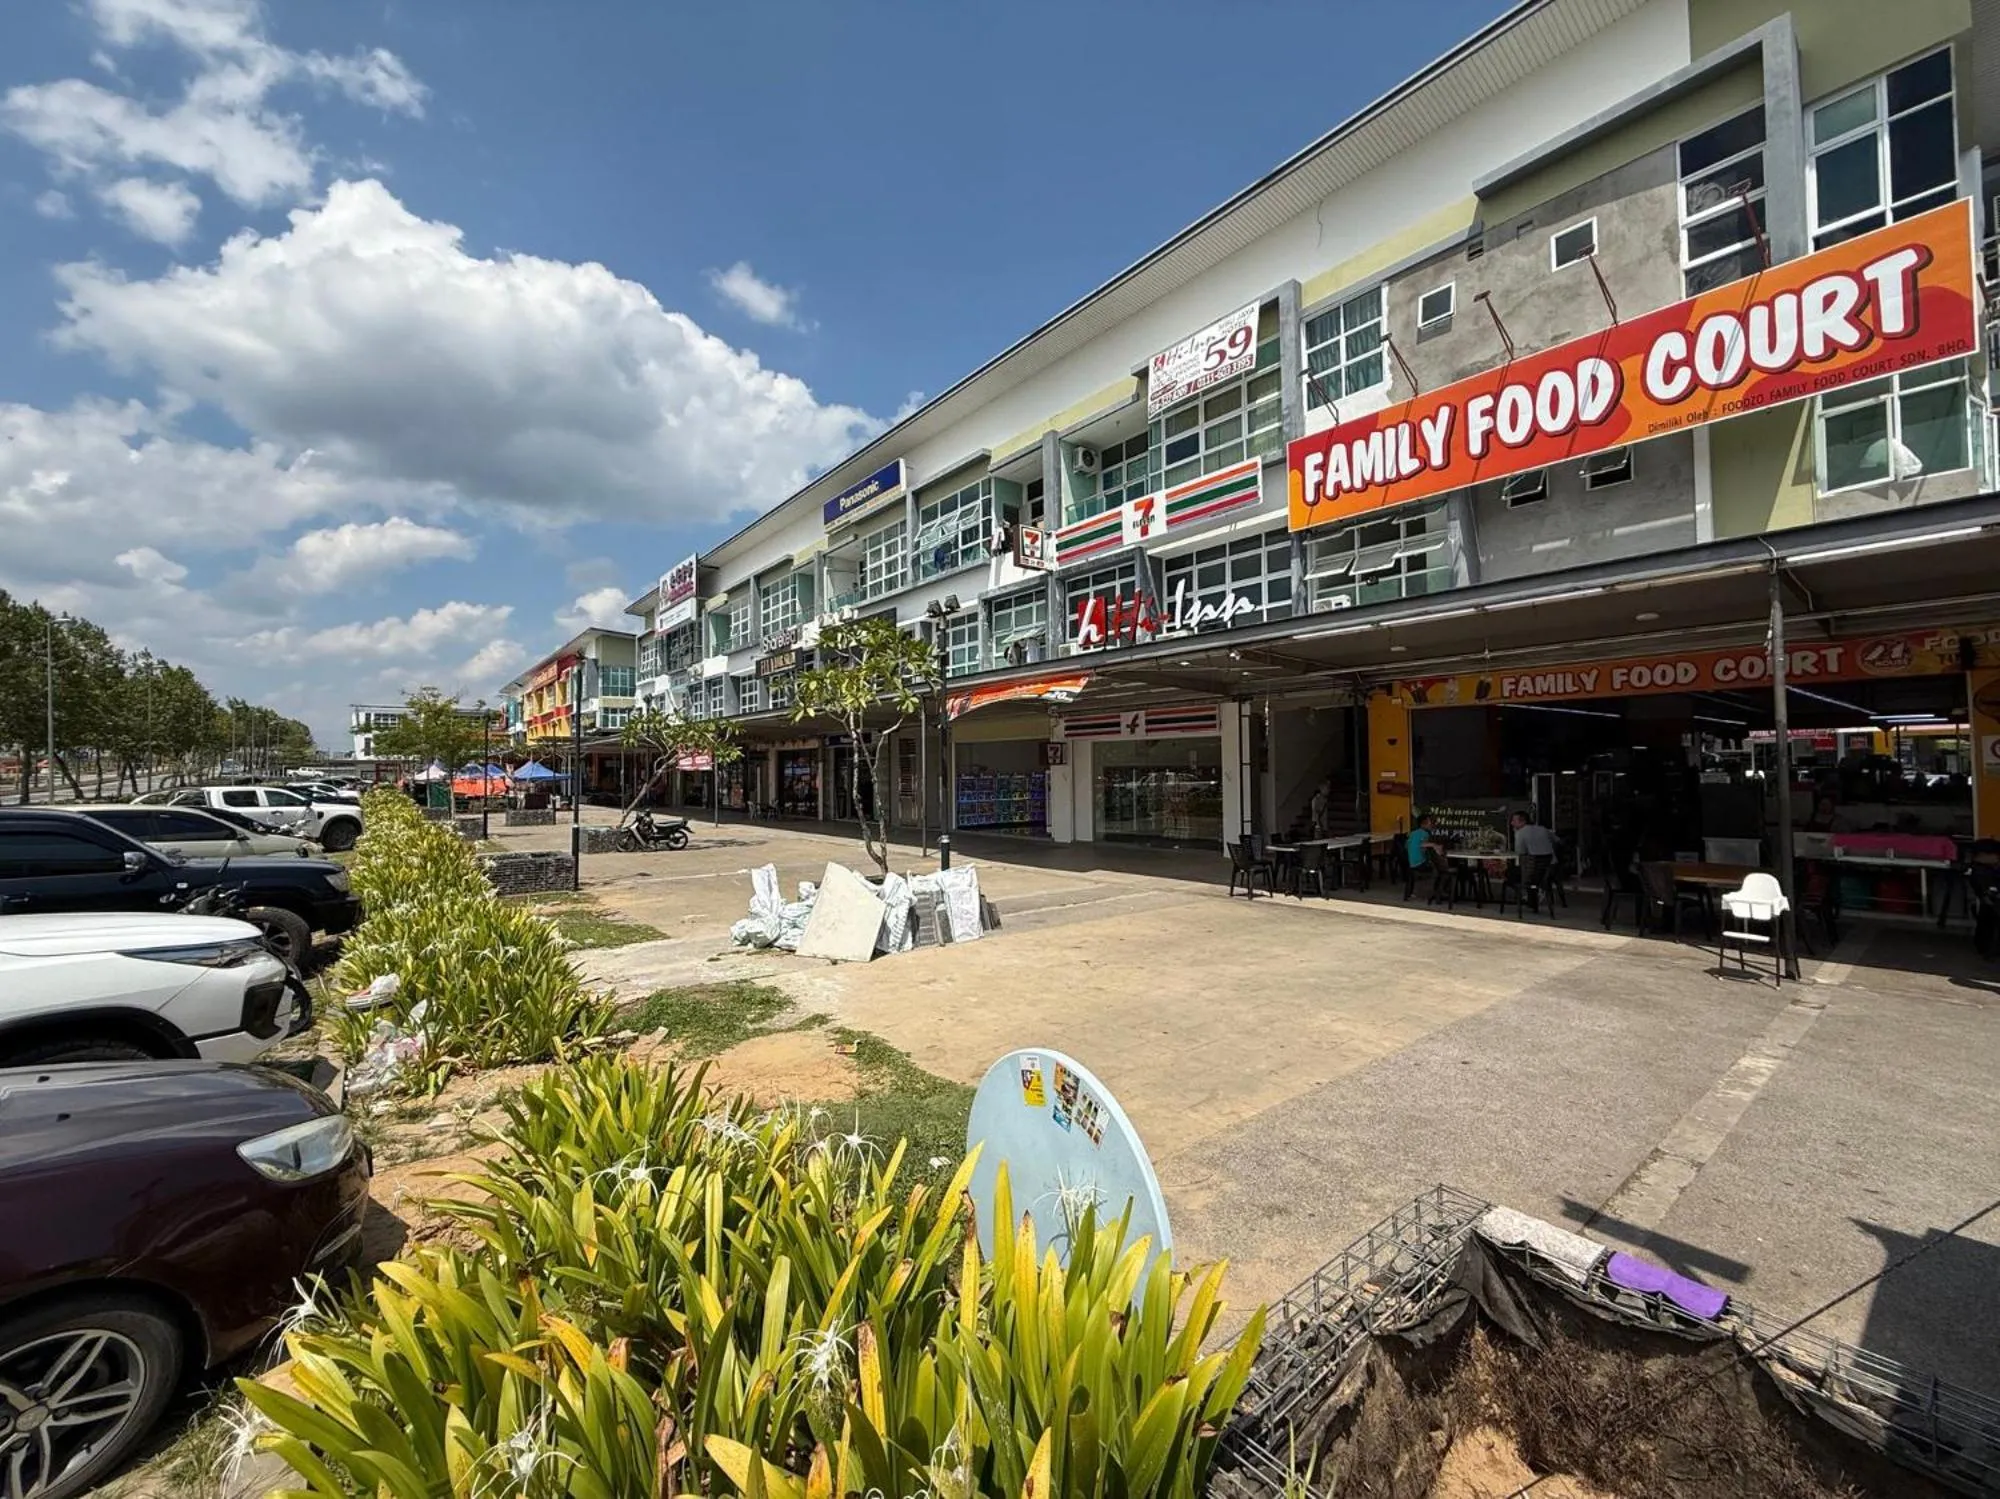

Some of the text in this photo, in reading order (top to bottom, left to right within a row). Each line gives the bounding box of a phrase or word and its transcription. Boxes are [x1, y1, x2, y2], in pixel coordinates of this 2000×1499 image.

[1203, 325, 1253, 372] 59
[1303, 243, 1932, 506] FAMILY FOOD COURT
[1648, 416, 1683, 434] Dimiliki
[1769, 381, 1808, 401] FAMILY
[1813, 372, 1847, 391] FOOD
[1852, 360, 1897, 382] COURT
[1900, 351, 1932, 369] SDN.
[839, 480, 880, 511] Panasonic
[1134, 497, 1154, 538] 7
[1501, 667, 1600, 700] FAMILY
[1612, 661, 1699, 691] FOOD
[1428, 806, 1486, 817] Makanan
